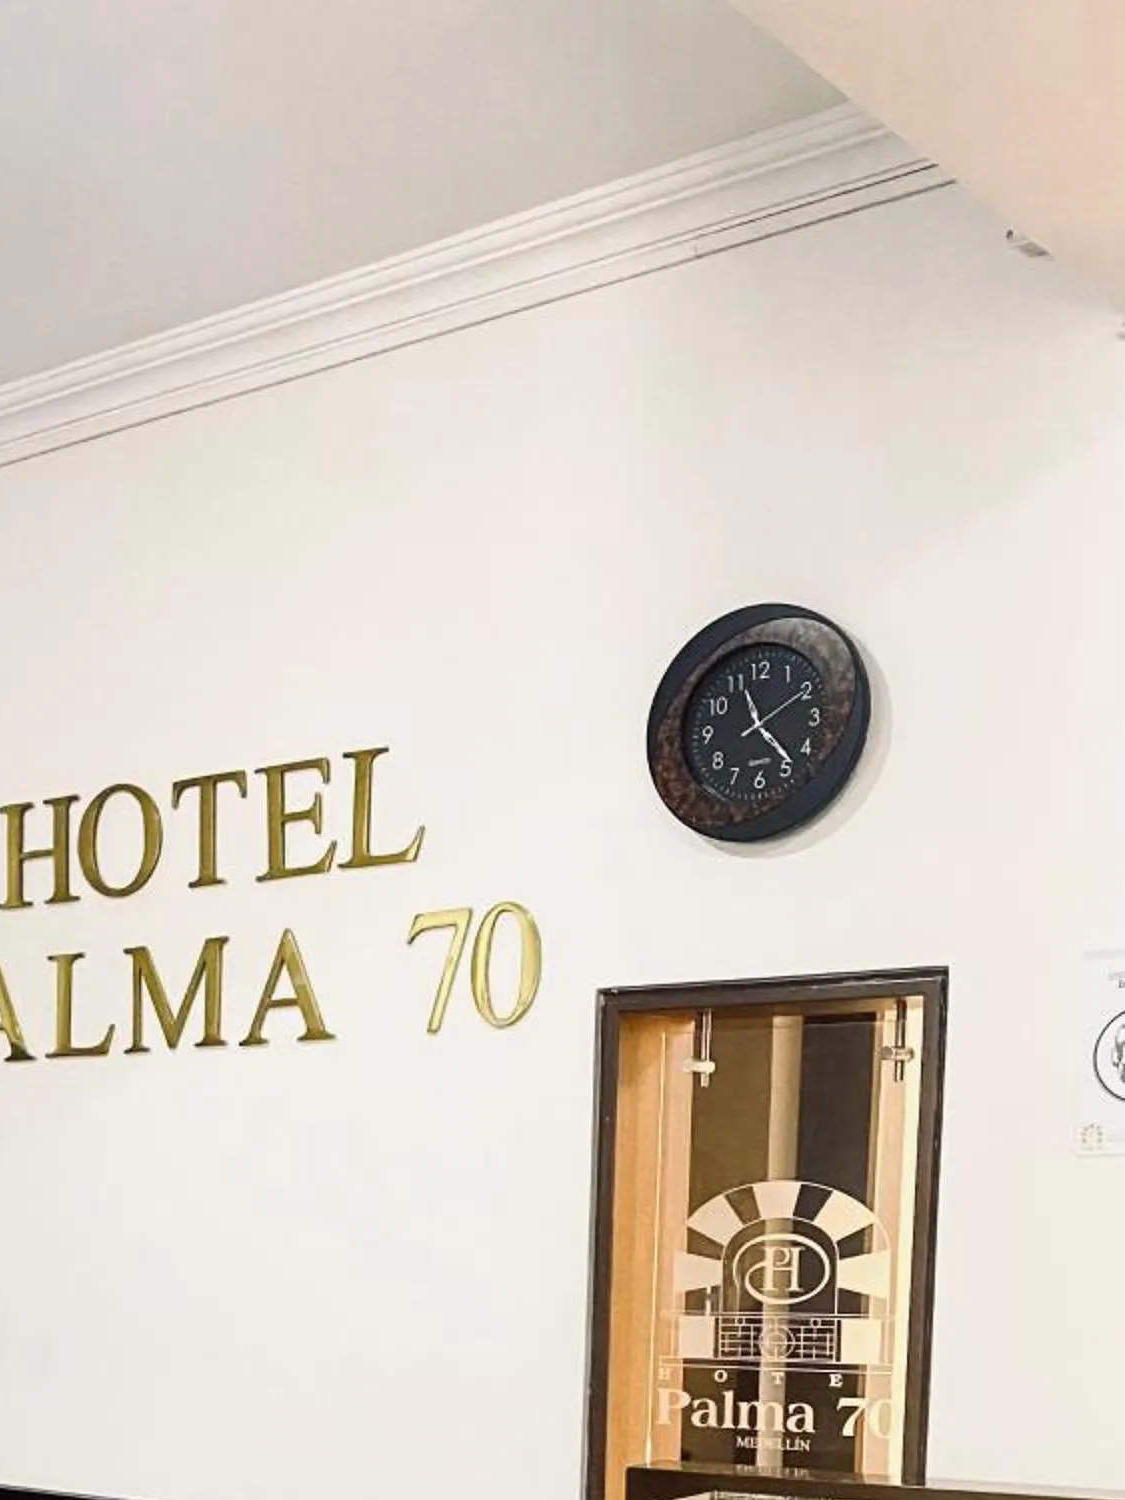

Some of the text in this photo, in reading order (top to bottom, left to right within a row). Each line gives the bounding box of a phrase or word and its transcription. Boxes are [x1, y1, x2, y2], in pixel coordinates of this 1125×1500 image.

[751, 661, 771, 680] 12
[784, 665, 791, 682] 1
[728, 674, 744, 692] 11
[801, 681, 813, 700] 2
[709, 696, 728, 715] 10
[809, 708, 820, 727] 3
[702, 725, 714, 745] 9
[800, 738, 812, 756] 4
[712, 752, 724, 770] 8
[779, 760, 792, 778] 5
[729, 768, 740, 785] 7
[754, 771, 766, 789] 6
[406, 900, 543, 1034] 70
[656, 1387, 894, 1439] Palma 70
